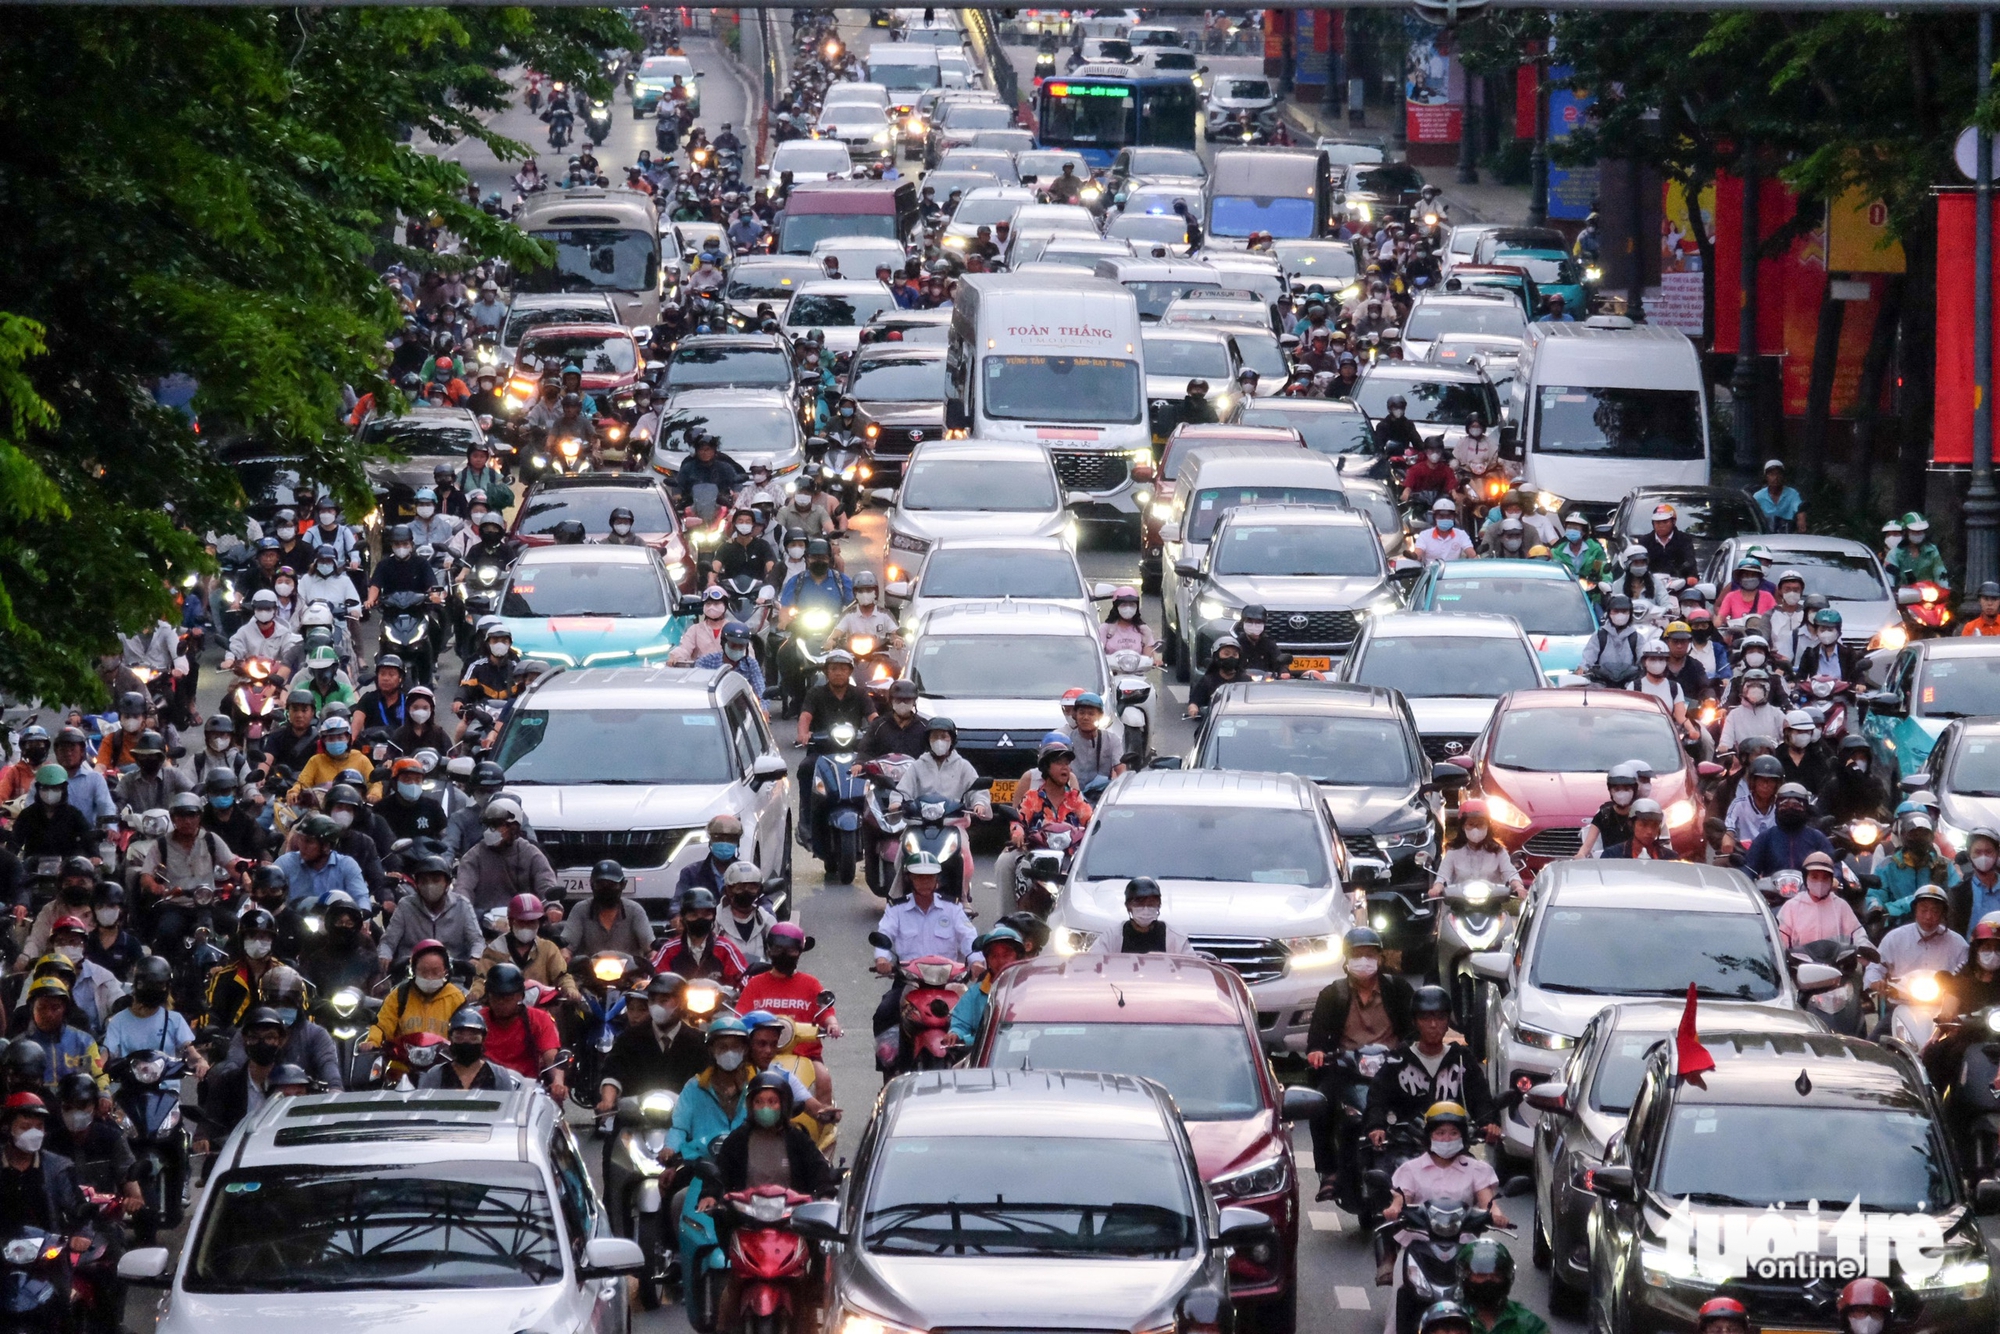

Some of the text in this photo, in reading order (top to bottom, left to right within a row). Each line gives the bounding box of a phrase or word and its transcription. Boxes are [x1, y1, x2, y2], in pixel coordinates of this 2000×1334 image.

[1008, 323, 1113, 339] TOÀN THẮNG
[753, 998, 812, 1011] BURBERRY
